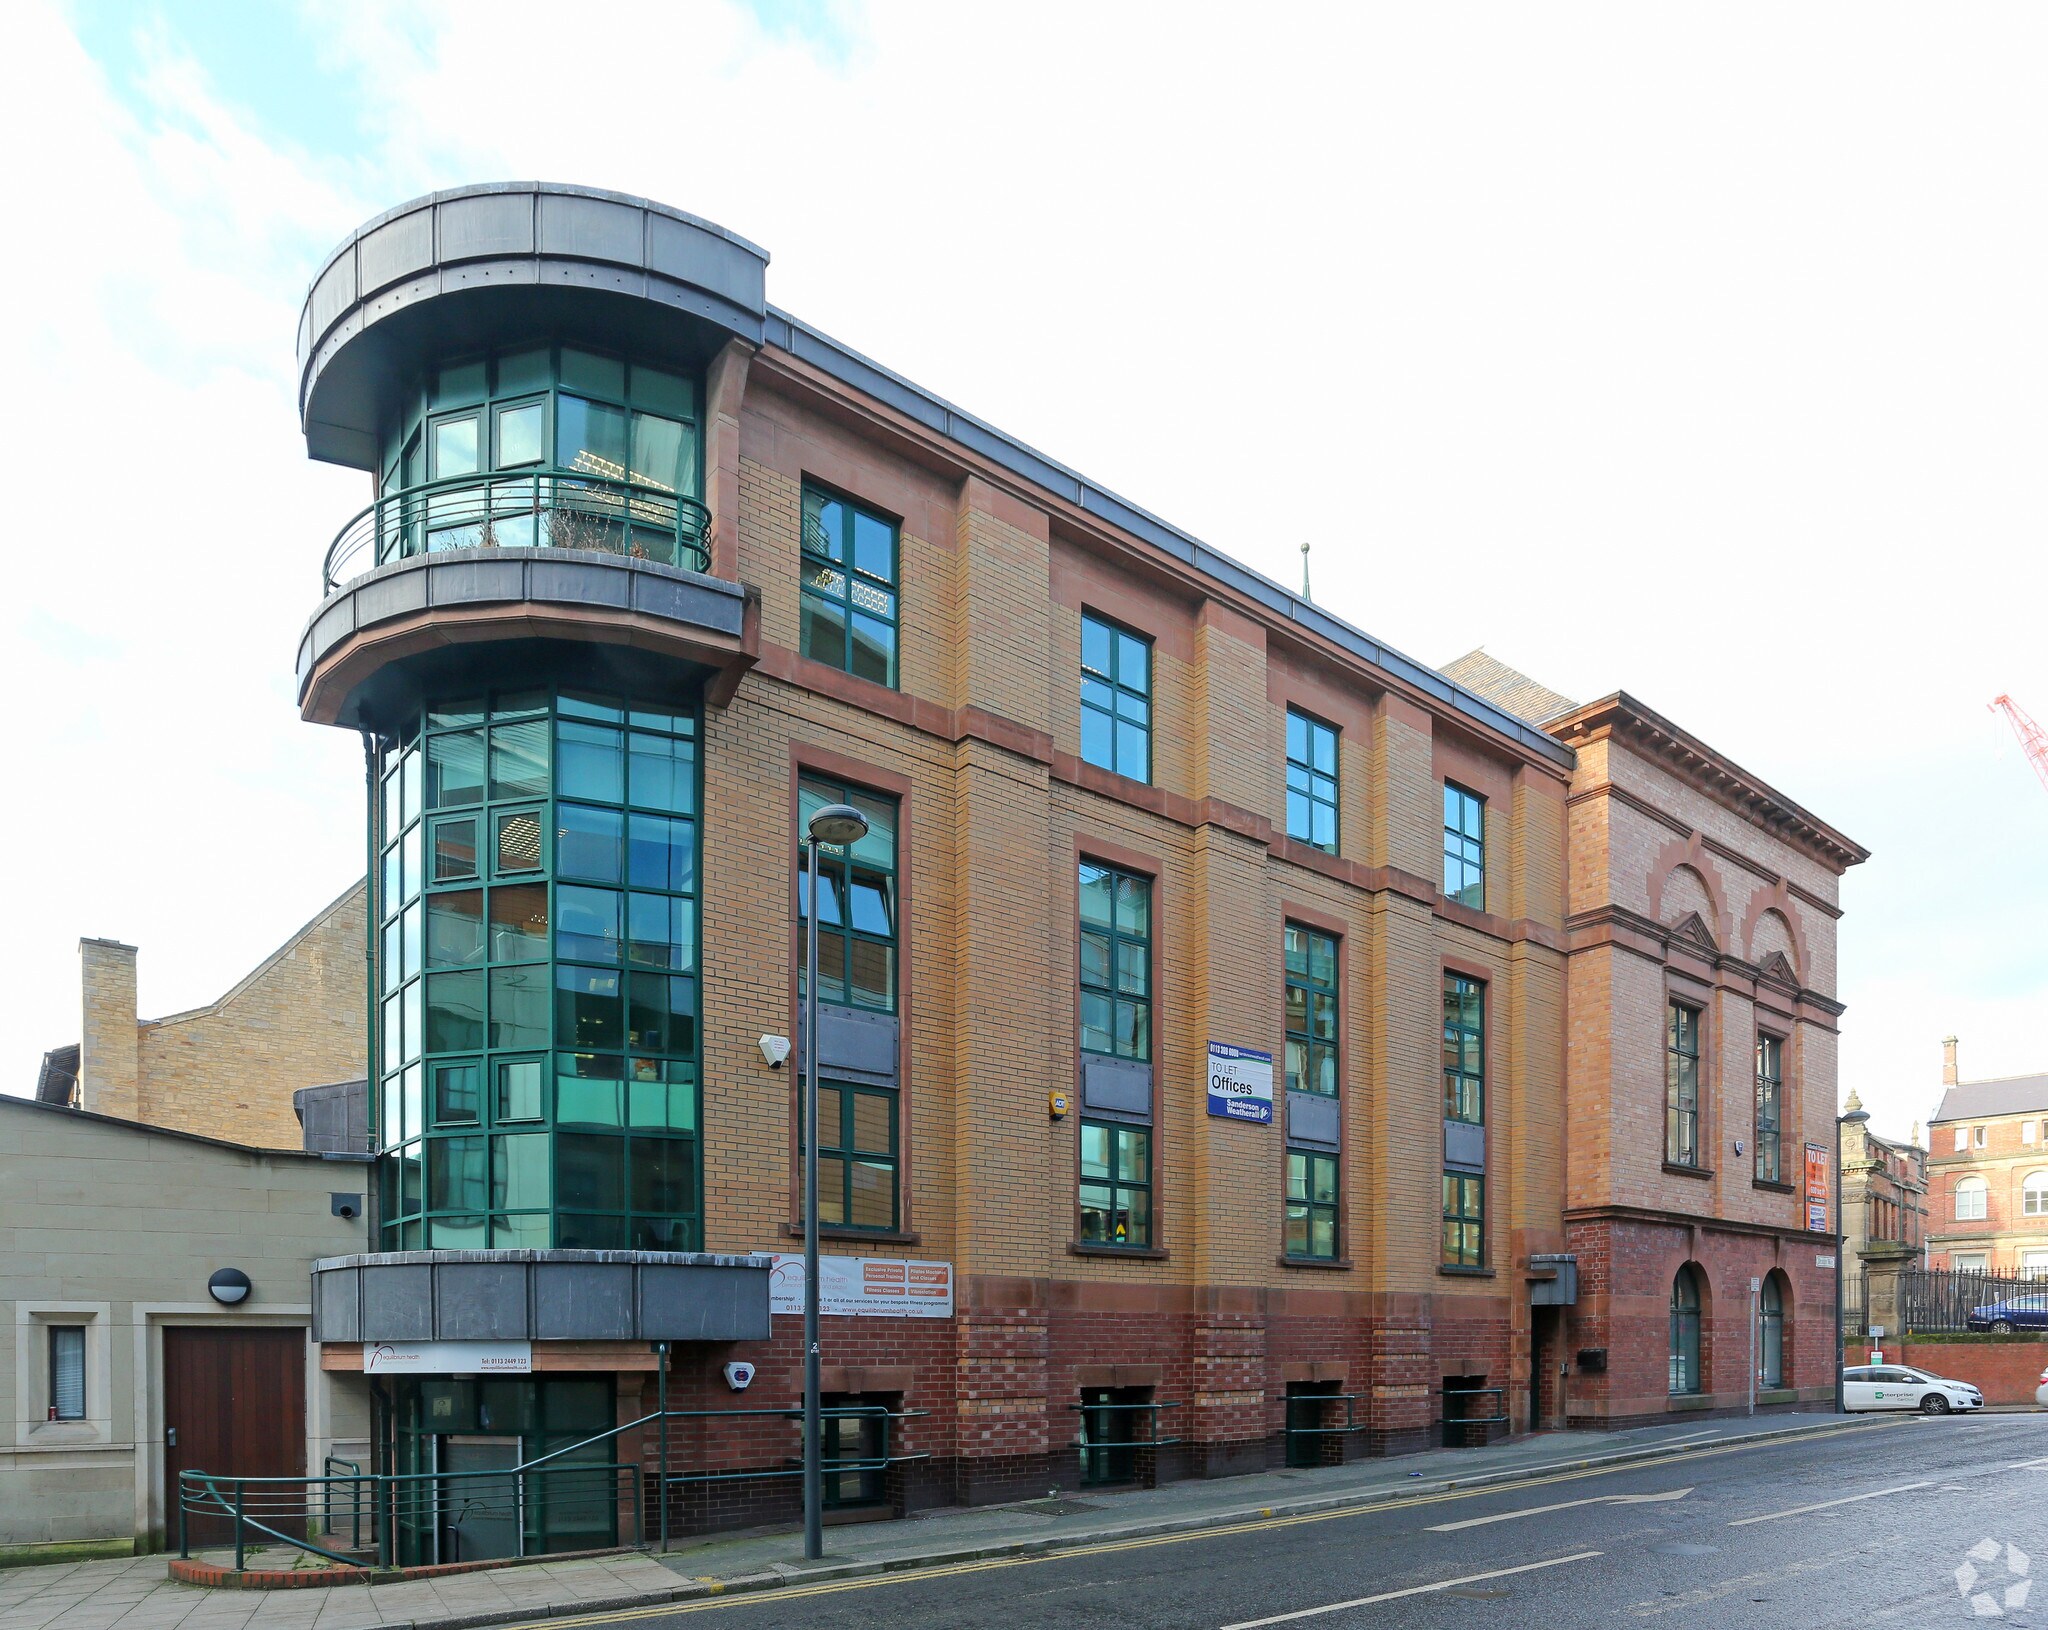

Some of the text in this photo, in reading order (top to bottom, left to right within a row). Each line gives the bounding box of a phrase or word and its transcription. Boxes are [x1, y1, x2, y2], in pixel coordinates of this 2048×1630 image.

[1212, 1062, 1238, 1076] TO LET
[1212, 1074, 1252, 1095] Offices
[1226, 1098, 1260, 1112] Sanderson
[1226, 1106, 1260, 1118] Weatherall
[1808, 1150, 1816, 1164] TO
